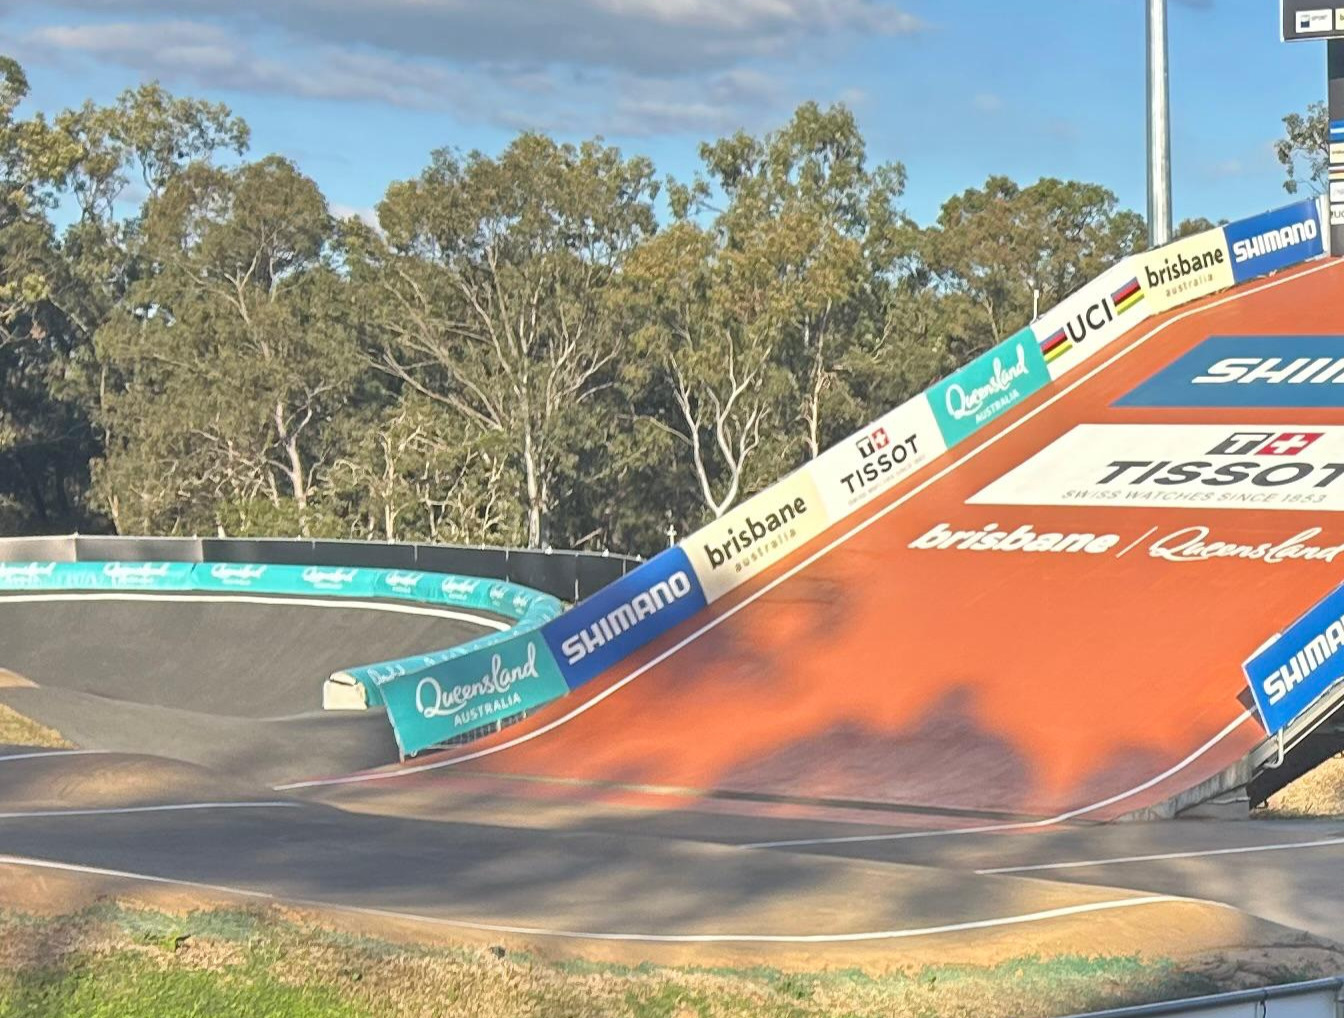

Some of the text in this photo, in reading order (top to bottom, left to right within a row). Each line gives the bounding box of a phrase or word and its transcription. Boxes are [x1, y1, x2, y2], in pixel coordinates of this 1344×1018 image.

[1233, 219, 1317, 263] SHIMANO
[1145, 248, 1224, 289] brisbane
[1166, 273, 1213, 298] australia
[1067, 298, 1113, 343] UCI
[945, 344, 1029, 421] Queensland
[975, 389, 1020, 424] AUSTRALIA
[840, 433, 917, 494] TISSOT
[1062, 490, 1122, 500] SWISS
[1125, 490, 1212, 501] WATCHES
[1218, 492, 1276, 503] SINCE
[704, 496, 808, 570] brisbane
[735, 528, 797, 573] australia
[908, 523, 1121, 556] brisbane
[561, 570, 691, 666] SHIMANO
[415, 641, 539, 718] Queensland
[454, 692, 522, 727] AUSTRALIA
